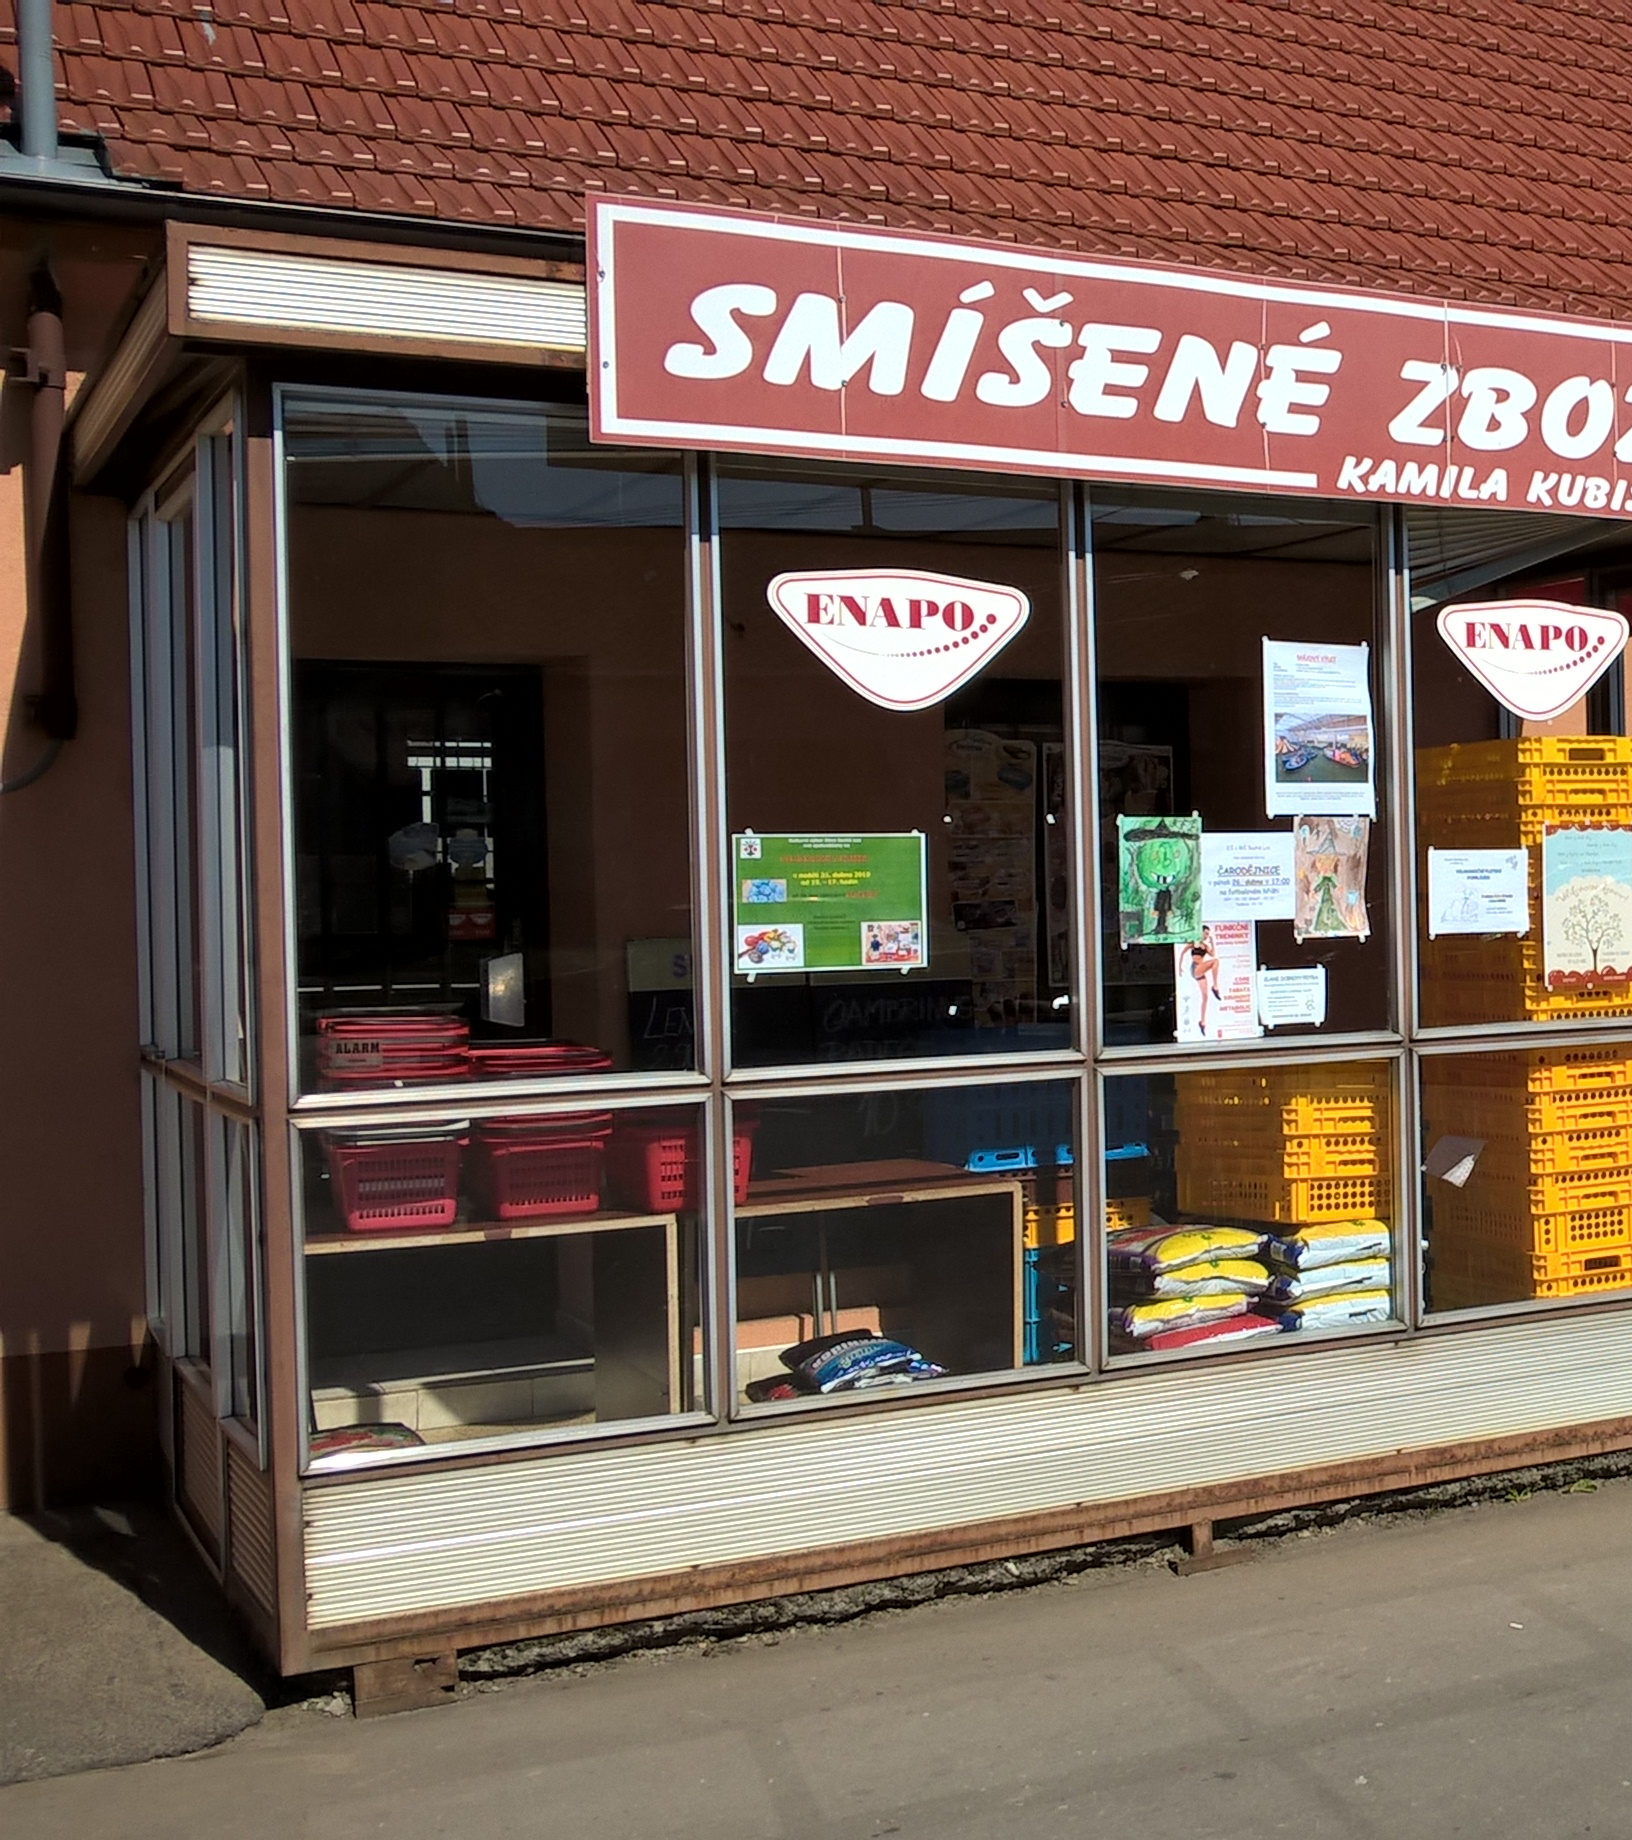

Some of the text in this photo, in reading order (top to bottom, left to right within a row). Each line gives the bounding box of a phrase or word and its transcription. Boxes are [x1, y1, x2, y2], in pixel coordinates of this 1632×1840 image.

[664, 281, 1343, 436] SMÍŠENÉ
[1336, 455, 1508, 502] KAMILA
[804, 593, 974, 632] ENAPO
[1464, 622, 1588, 652] ENAPO
[335, 1042, 380, 1054] ALARM
